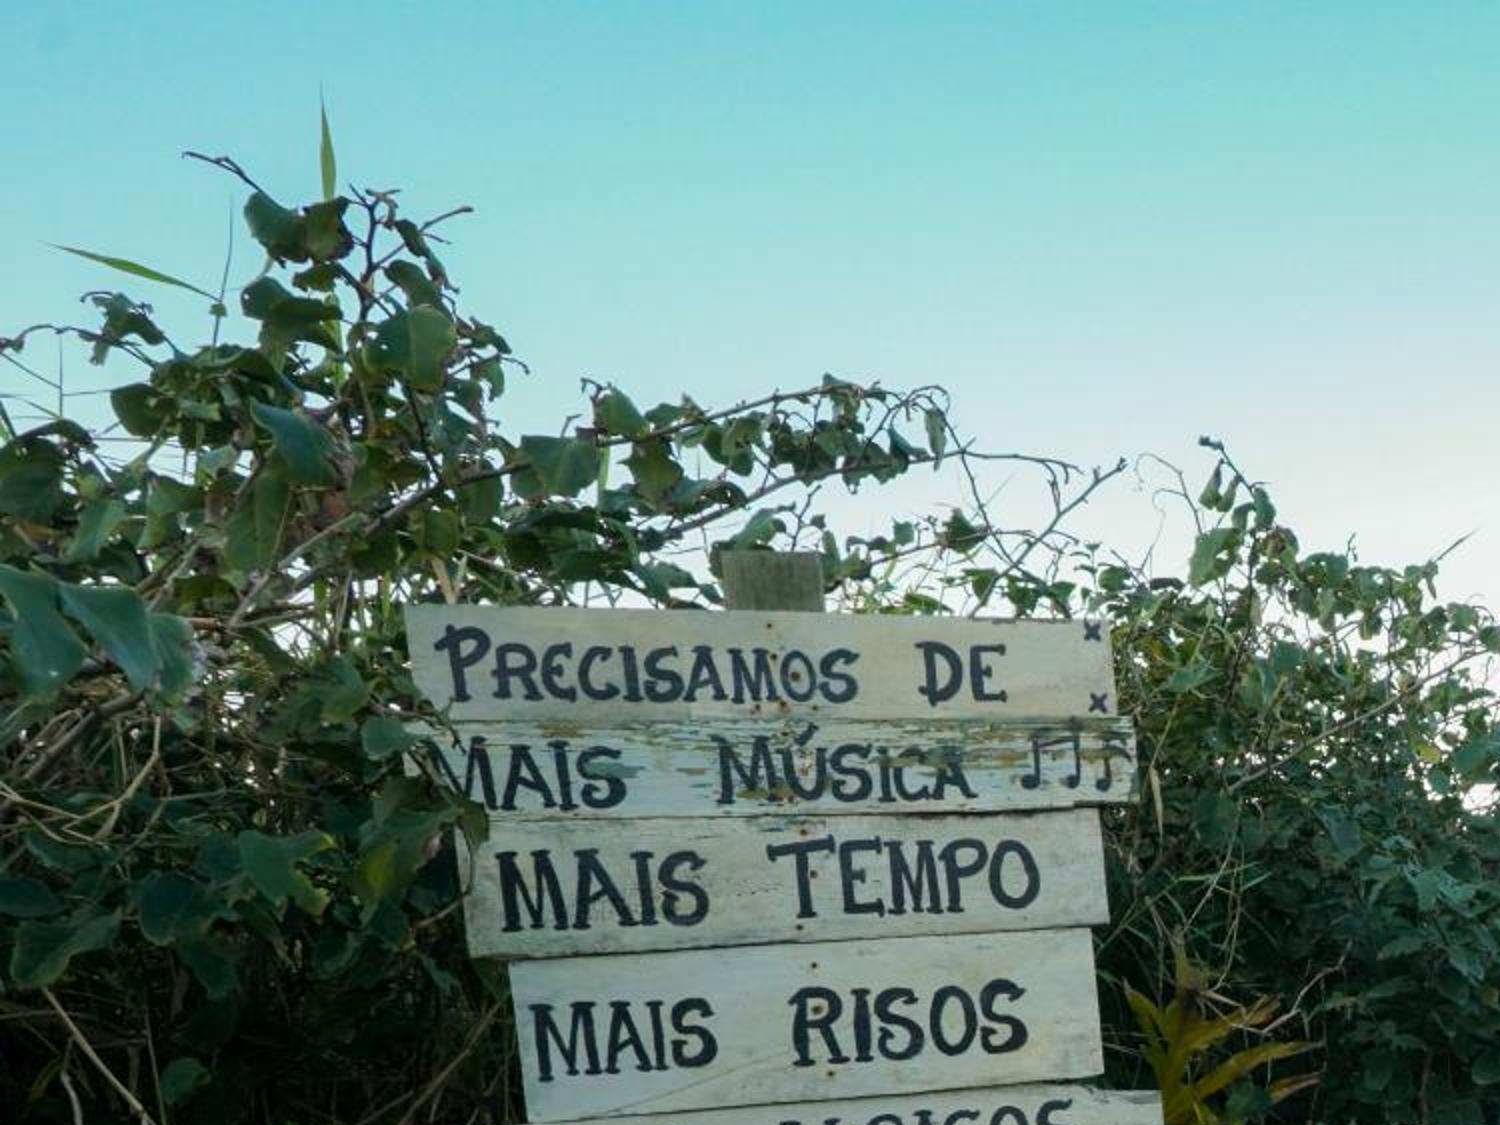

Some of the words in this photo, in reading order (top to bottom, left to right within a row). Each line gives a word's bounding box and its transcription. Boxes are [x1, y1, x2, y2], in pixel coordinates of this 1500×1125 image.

[434, 624, 861, 704] PRECISAMOS
[914, 640, 1007, 706] DE
[424, 735, 628, 812] MAIS
[495, 848, 712, 934] MAIS
[766, 834, 1042, 921] TEMPO
[527, 996, 719, 1082] MAIS
[787, 977, 1029, 1068] RISOS
